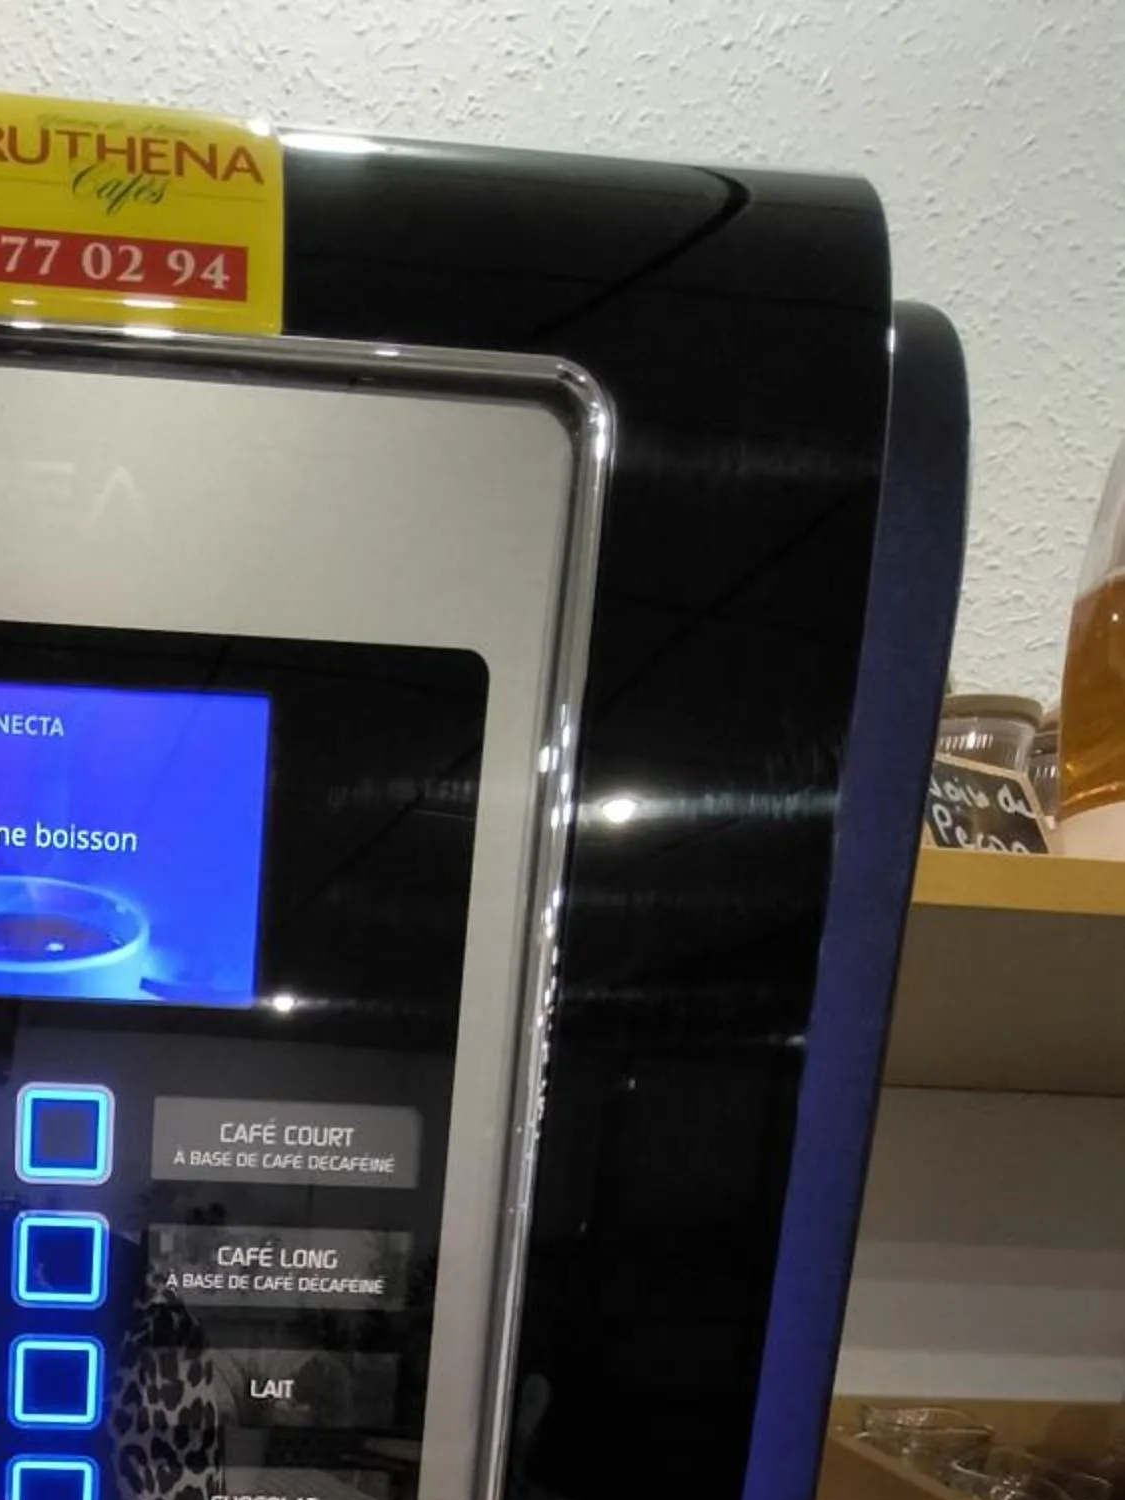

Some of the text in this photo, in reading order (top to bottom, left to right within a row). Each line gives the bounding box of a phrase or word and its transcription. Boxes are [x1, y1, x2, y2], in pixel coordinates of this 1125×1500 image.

[0, 235, 61, 276] 77
[81, 243, 144, 283] 02
[166, 249, 230, 290] 94
[35, 820, 137, 853] boisson
[219, 1117, 355, 1148] CAFÉ COURT
[190, 1151, 232, 1167] BASE
[236, 1152, 259, 1168] DE
[216, 1241, 339, 1270] CAFÉ LONG
[182, 1273, 224, 1290] BASE
[228, 1275, 249, 1291] DE
[250, 1379, 295, 1399] LAIT
